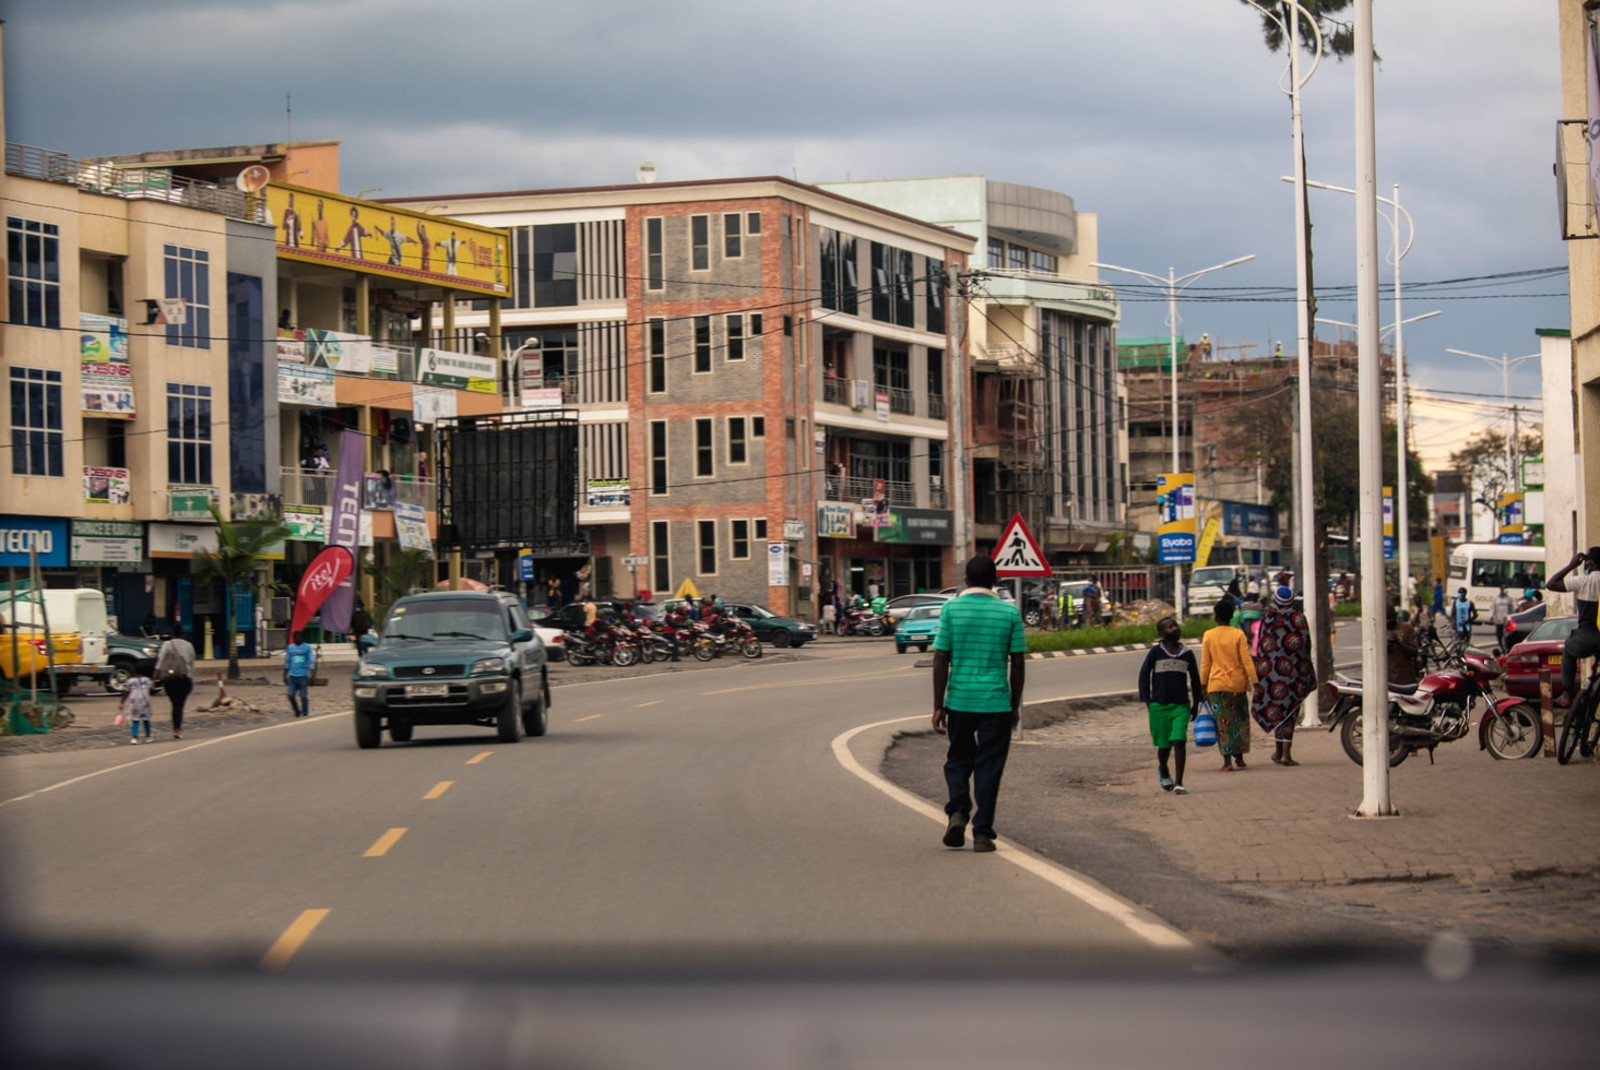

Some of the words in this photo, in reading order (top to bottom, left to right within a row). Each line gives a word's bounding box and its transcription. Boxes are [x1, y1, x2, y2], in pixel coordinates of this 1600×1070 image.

[334, 480, 360, 556] TECN
[0, 528, 53, 554] TECNO
[310, 561, 333, 591] itel
